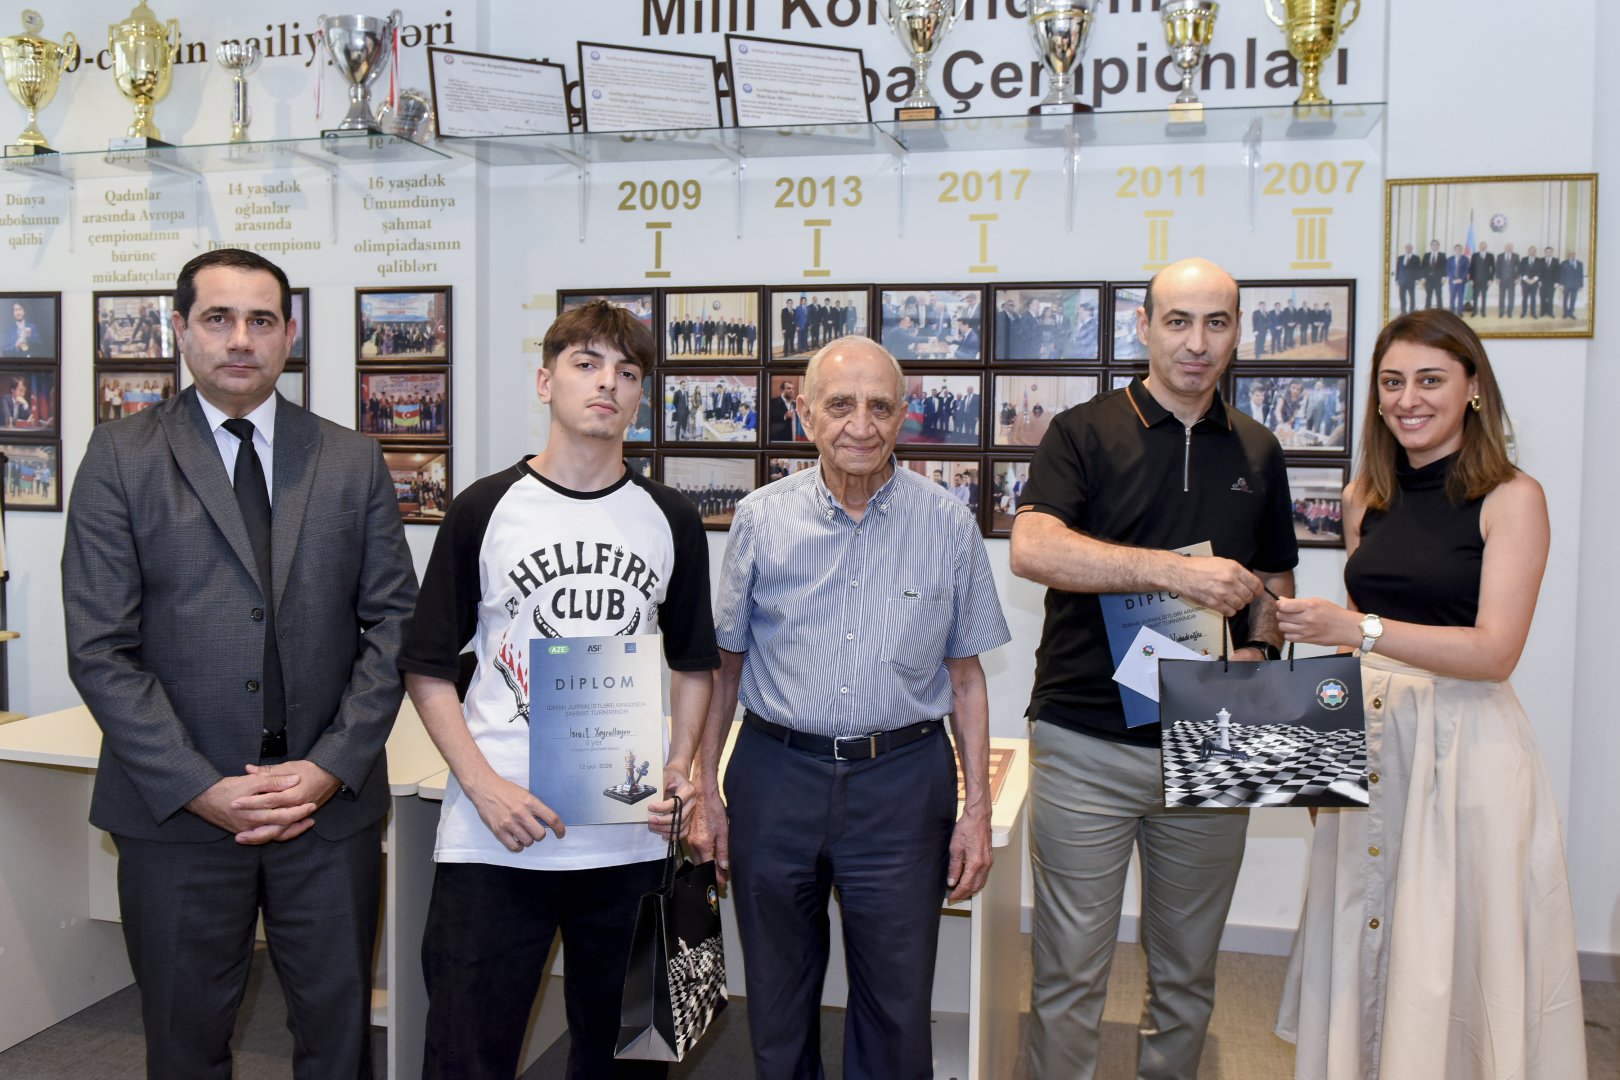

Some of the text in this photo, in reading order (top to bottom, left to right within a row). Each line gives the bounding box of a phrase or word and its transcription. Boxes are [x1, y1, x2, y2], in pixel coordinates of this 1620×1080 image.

[942, 38, 1348, 113] Çempionlaı
[369, 173, 446, 193] 16 yaşadək
[938, 168, 1031, 203] 2017
[1115, 164, 1206, 198] 2011
[1262, 160, 1365, 196] 2007
[104, 188, 162, 206] Qadınlar
[228, 180, 301, 198] 14 yaşadək
[617, 179, 701, 211] 2009
[774, 175, 863, 208] 2013
[5, 193, 46, 209] Dünya
[234, 201, 291, 218] oğlanlar
[362, 193, 456, 212] Ümumdünya
[82, 209, 186, 225] arasında Avropa
[234, 217, 292, 231] arasında
[381, 217, 432, 234] şahmat
[8, 232, 43, 250] qalibi
[88, 229, 180, 247] çempionatının
[353, 237, 462, 256] olimpiadasının
[1290, 207, 1333, 270] III
[111, 249, 157, 262] bürünc
[507, 540, 660, 601] HELLFIRE
[551, 587, 625, 621] CLUB
[1124, 590, 1179, 610] DİPLO
[555, 675, 634, 691] DİPLOM
